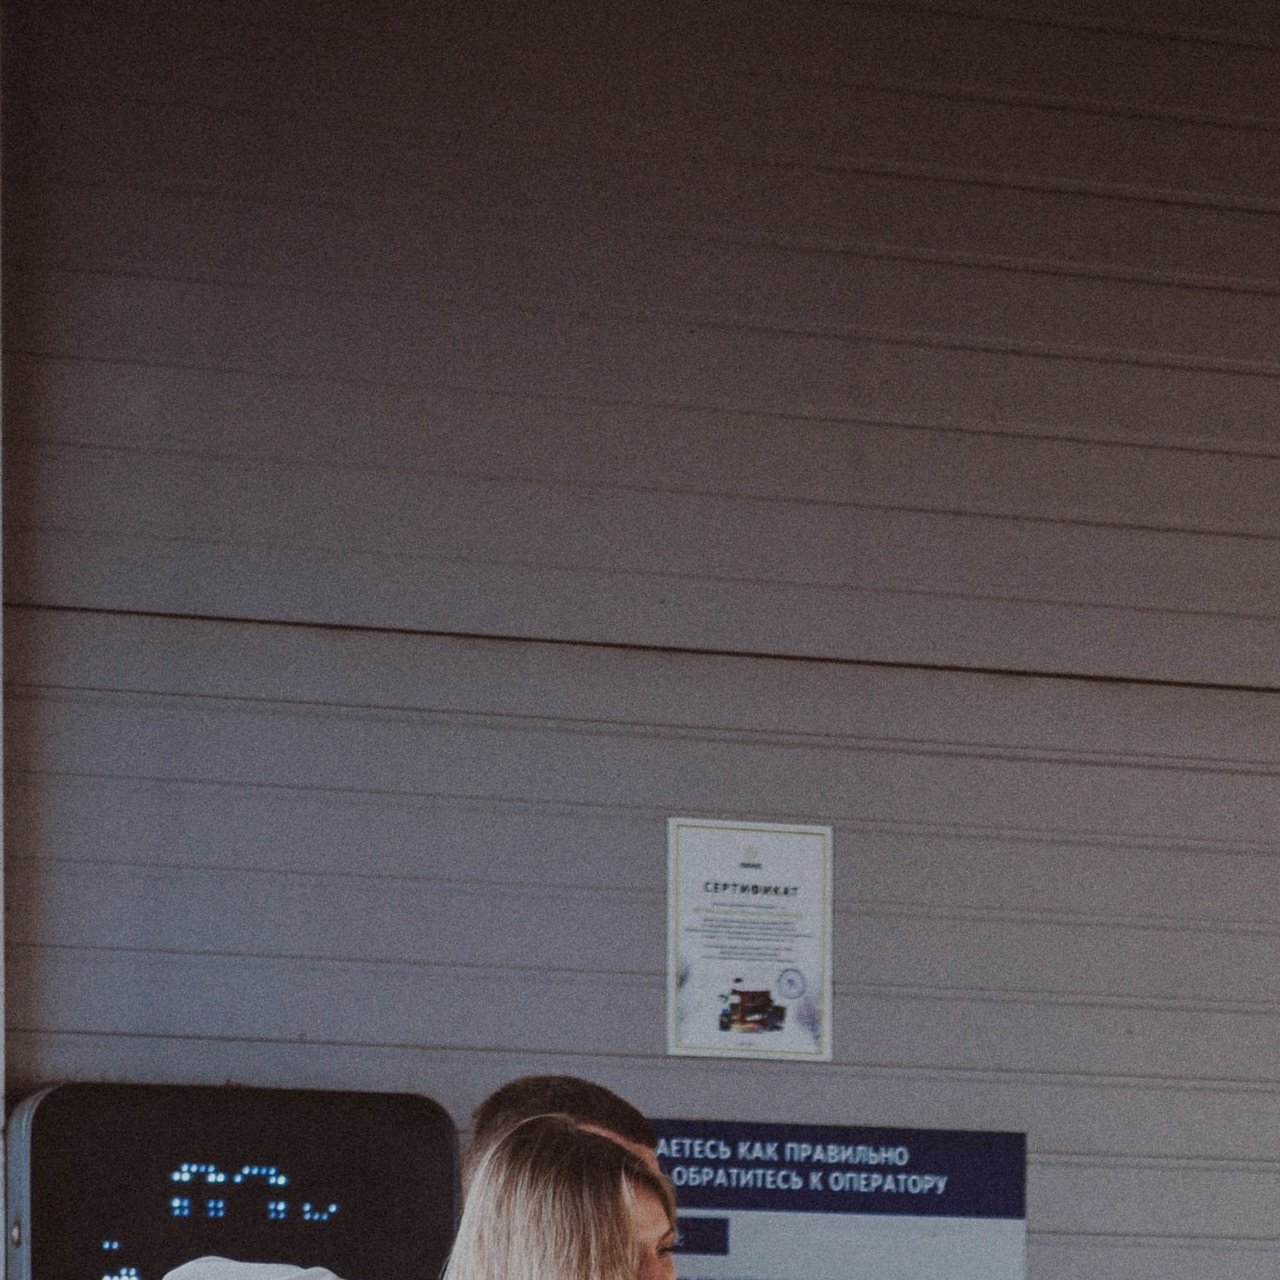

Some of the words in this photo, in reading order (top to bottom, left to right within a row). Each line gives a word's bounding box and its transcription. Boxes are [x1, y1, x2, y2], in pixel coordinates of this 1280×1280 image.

[704, 881, 799, 897] СЕРТИФИКАТ
[737, 1141, 779, 1162] КАК
[785, 1142, 909, 1167] ПРАВИЛЬНО
[672, 1166, 803, 1191] ОБРАТИТЕСЬ
[809, 1171, 823, 1191] К
[829, 1172, 948, 1196] ОПЕРАТОРУ
